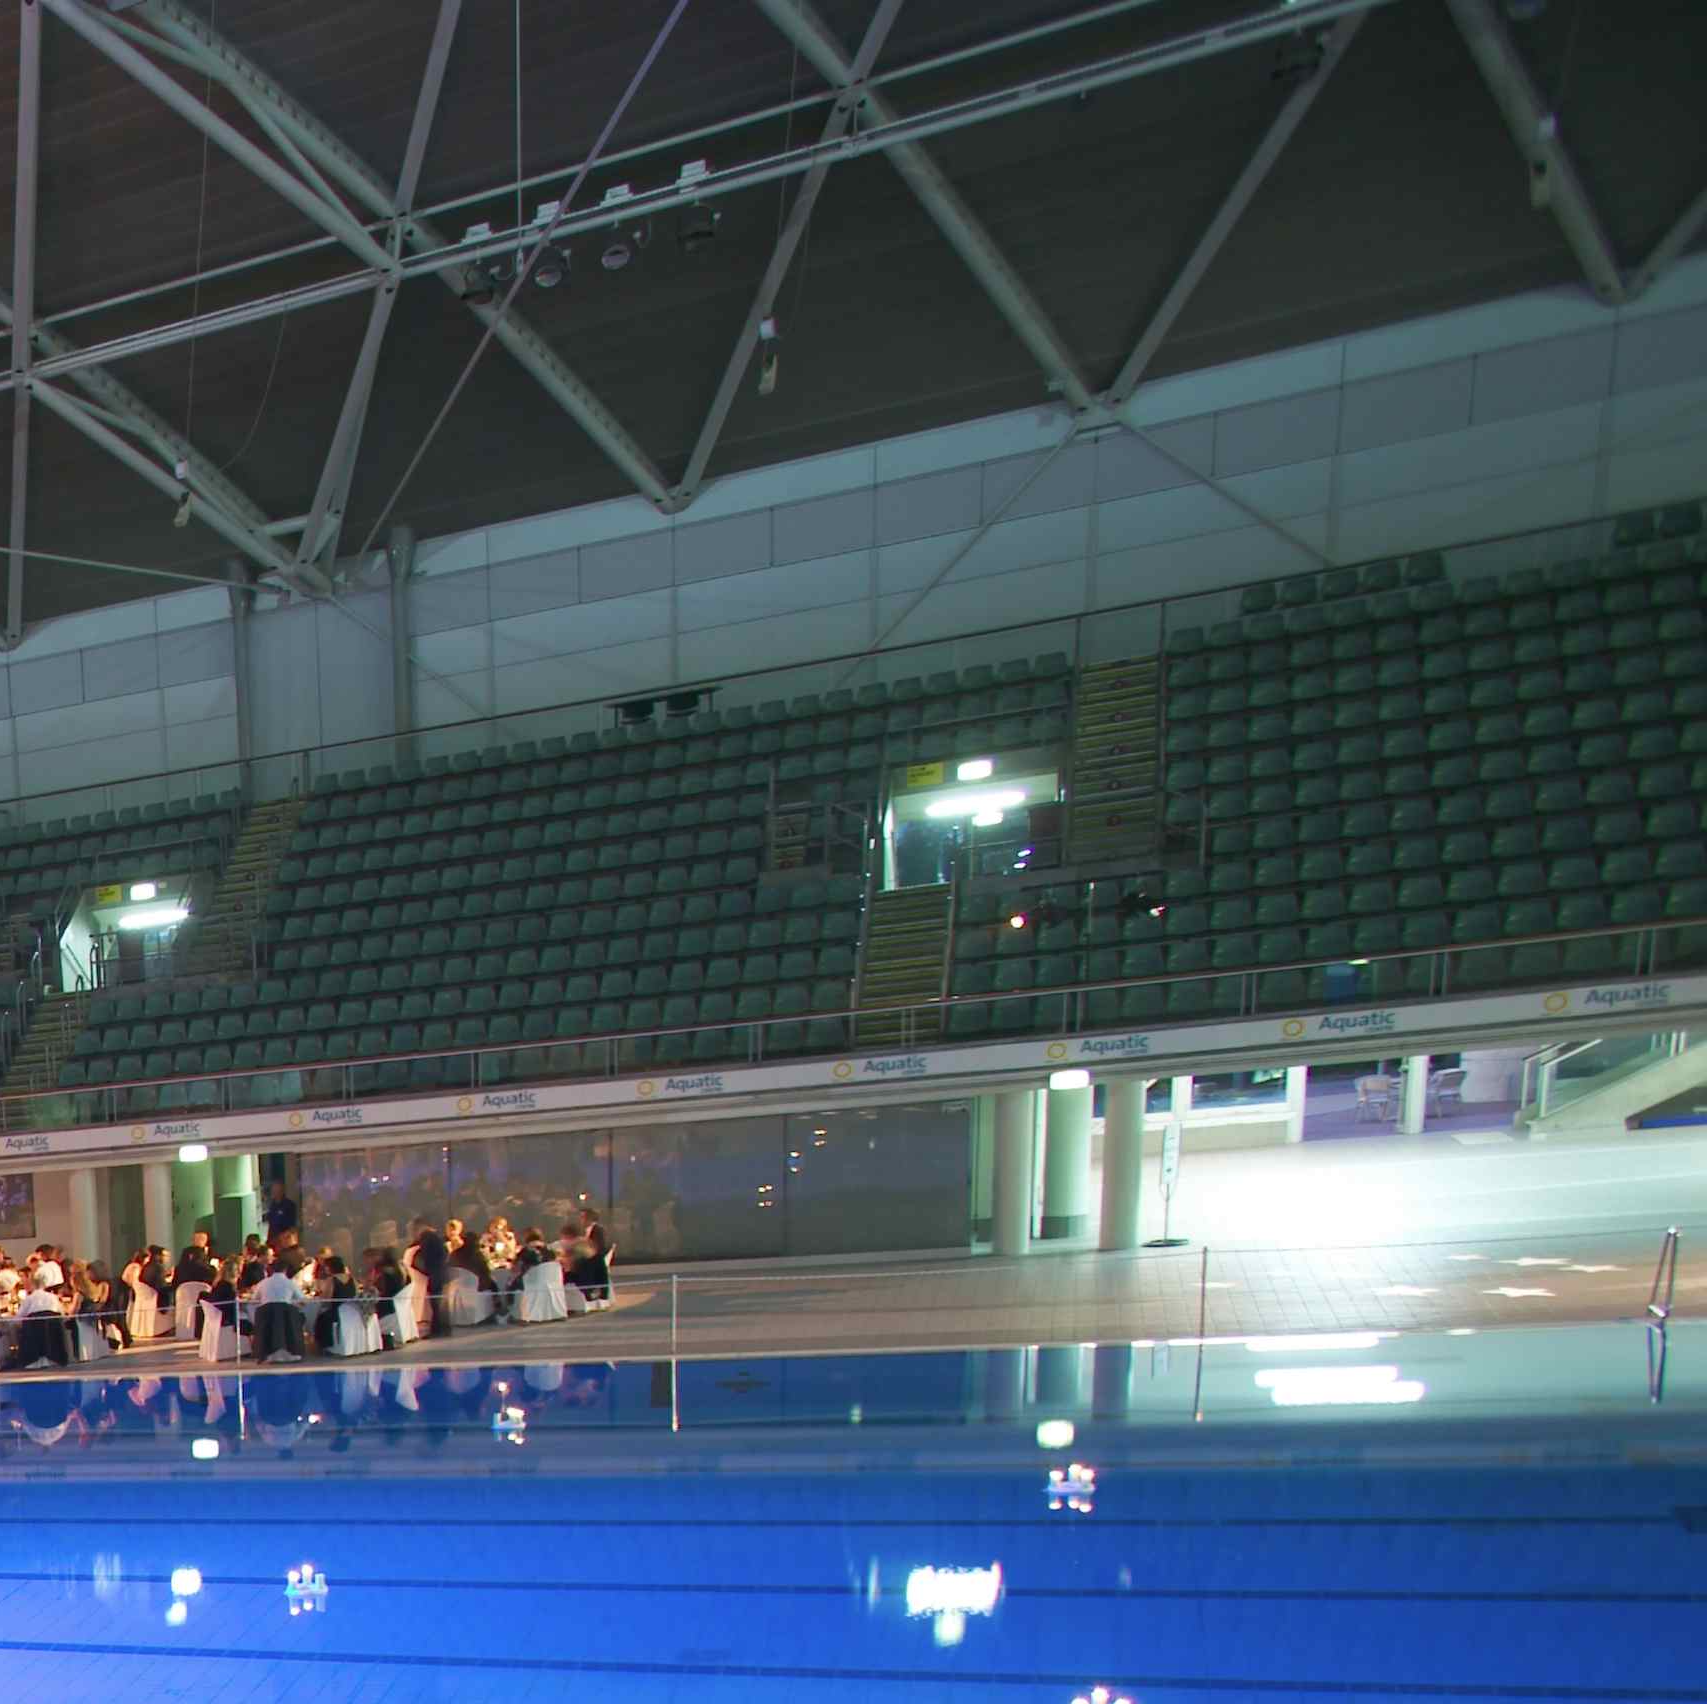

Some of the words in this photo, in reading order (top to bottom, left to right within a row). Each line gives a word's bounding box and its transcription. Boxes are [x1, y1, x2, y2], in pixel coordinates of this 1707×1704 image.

[1584, 983, 1670, 1007] Aquatic
[1318, 1010, 1396, 1033] Aquatic
[1080, 1035, 1149, 1054] Aquatic
[863, 1055, 927, 1074] Aquatic
[665, 1074, 723, 1092] Aquatic
[482, 1091, 536, 1107] Aquatic
[312, 1108, 362, 1123] Aquatic
[154, 1122, 200, 1137] Aquatic
[5, 1135, 49, 1150] Aquatic
